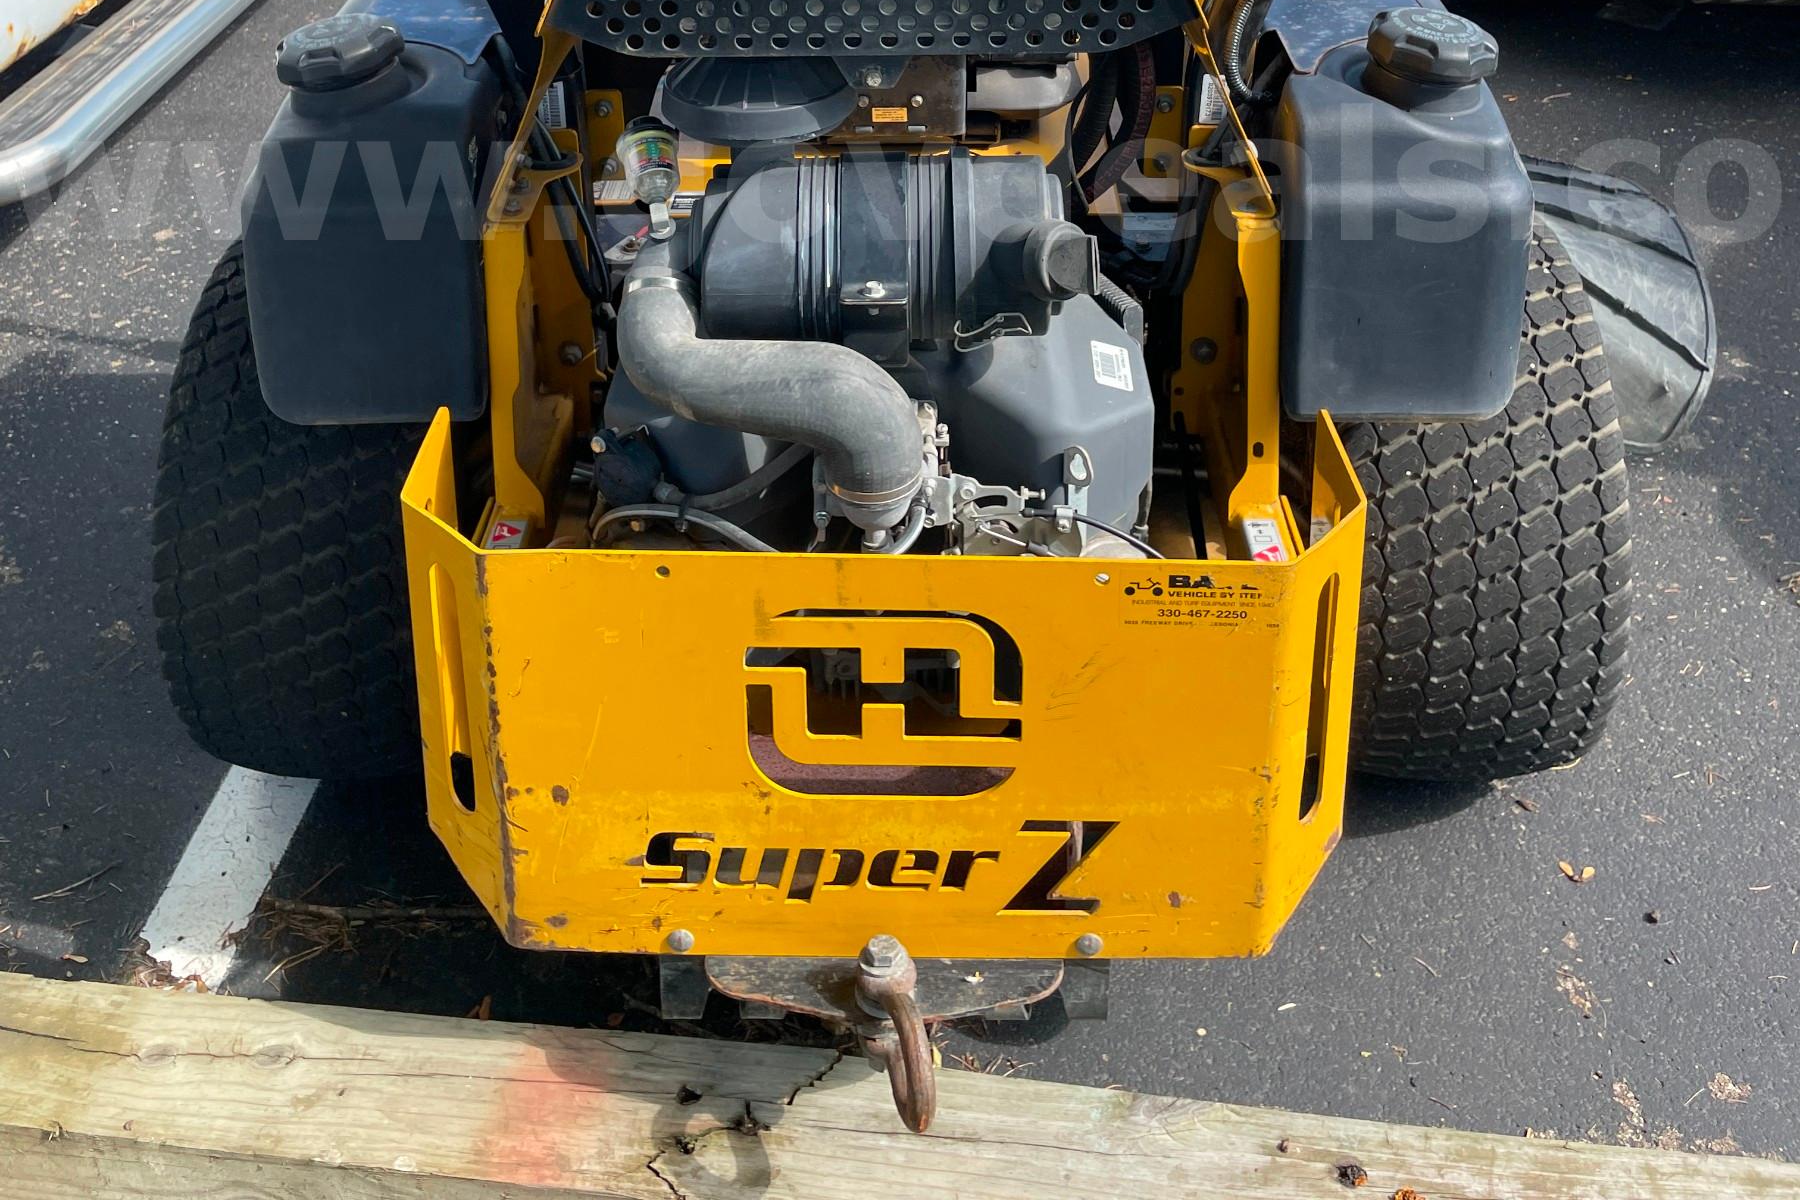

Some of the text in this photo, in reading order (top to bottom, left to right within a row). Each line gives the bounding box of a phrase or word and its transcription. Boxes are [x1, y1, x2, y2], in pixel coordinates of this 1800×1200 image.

[1168, 591, 1216, 599] VEHICLE
[1158, 609, 1247, 619] 330-467-2250
[640, 819, 1121, 917] Super Z
